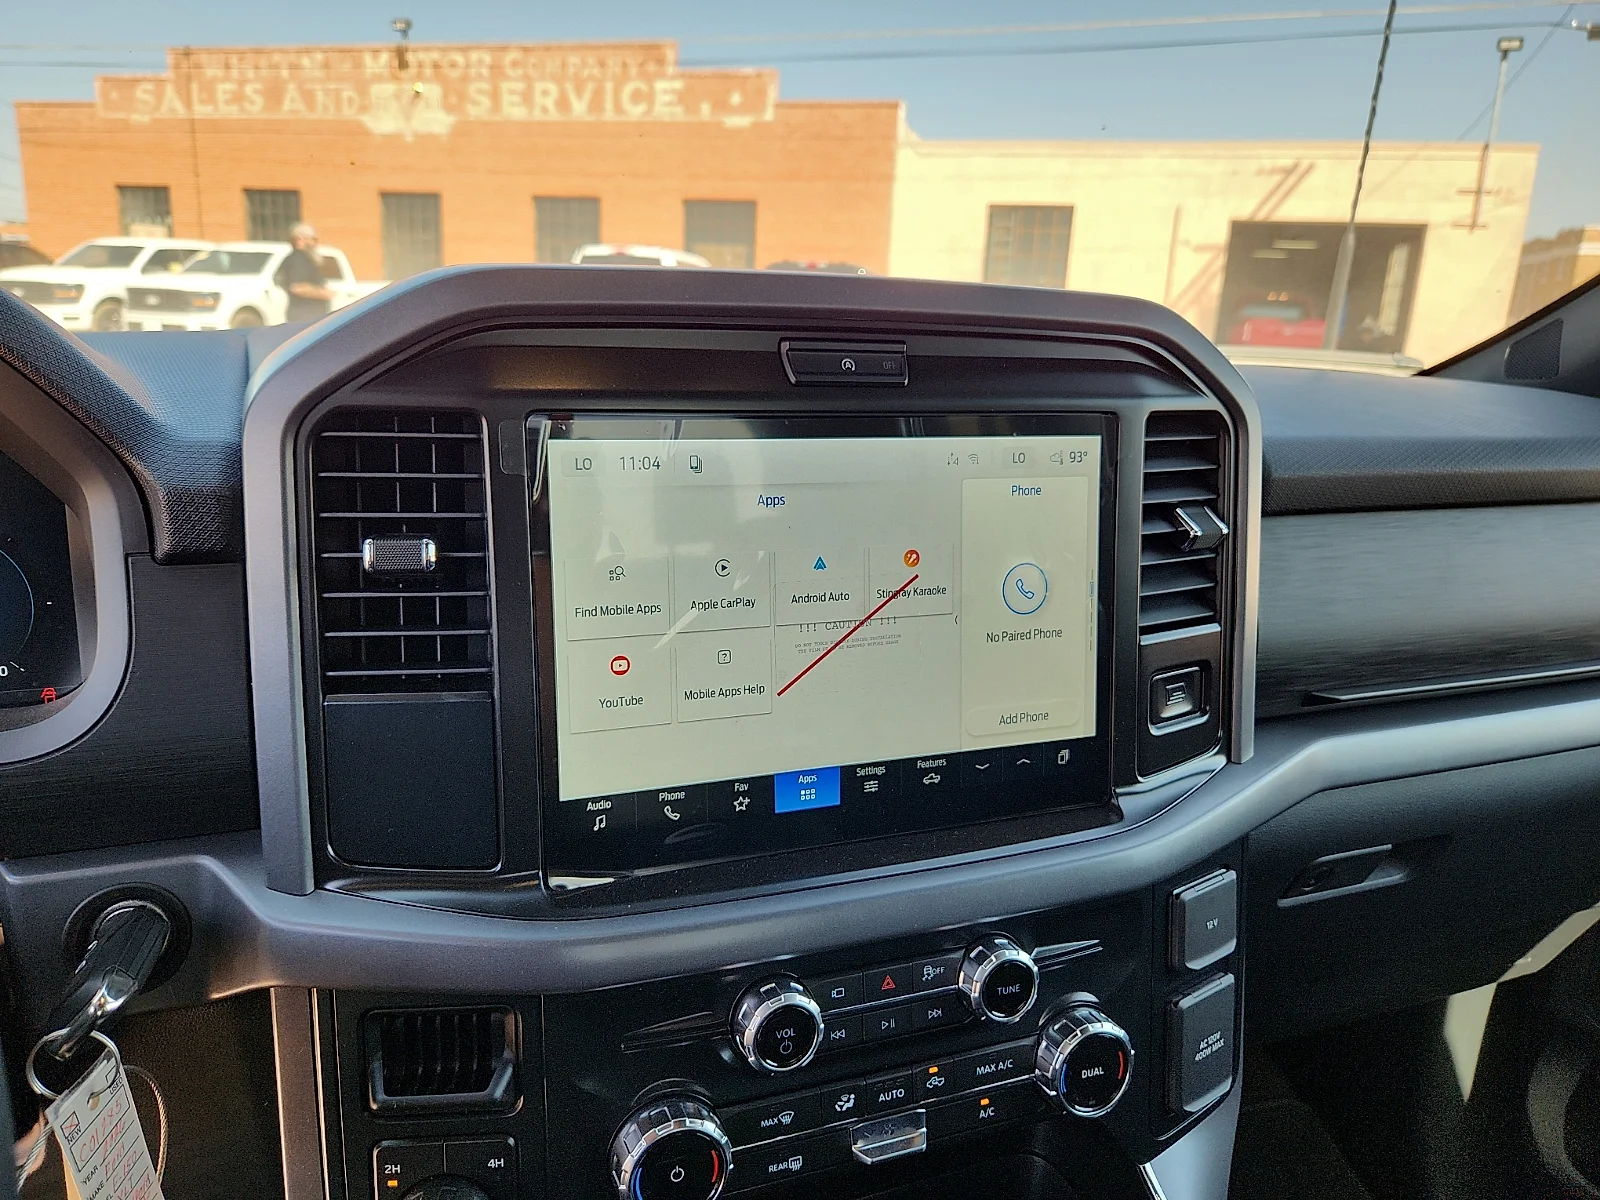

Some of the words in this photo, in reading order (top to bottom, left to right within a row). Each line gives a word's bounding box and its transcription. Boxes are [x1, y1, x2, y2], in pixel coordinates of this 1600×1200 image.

[135, 82, 264, 115] SALES
[282, 82, 360, 115] AND
[467, 79, 685, 118] SERVICE
[882, 361, 896, 370] OFF
[619, 456, 662, 471] 11:04
[1012, 452, 1026, 464] LO
[1069, 451, 1088, 463] 93°
[574, 457, 593, 471] LO
[1011, 485, 1042, 497] Phone
[757, 494, 787, 508] Apps
[913, 584, 947, 597] Karaoke
[791, 591, 827, 605] Android
[828, 590, 850, 602] Auto
[574, 607, 598, 618] Find
[600, 604, 634, 617] Mobile
[636, 602, 662, 616] Apps
[690, 599, 719, 613] Apple
[720, 597, 756, 610] CarPlay
[986, 632, 1000, 643] No
[1001, 629, 1032, 642] Paired
[1033, 628, 1063, 640] Phone
[684, 687, 716, 701] Mobile
[717, 686, 742, 700] Apps
[743, 684, 766, 697] Help
[598, 695, 644, 709] YouTube
[998, 713, 1018, 726] Add
[1019, 711, 1049, 723] Phone
[917, 758, 947, 769] Features
[856, 765, 886, 777] Settings
[798, 773, 818, 784] Apps
[734, 782, 749, 792] Fav
[658, 790, 686, 802] Phone
[586, 799, 612, 811] Audio
[1206, 917, 1218, 930] 12V
[931, 964, 946, 976] OFF
[997, 982, 1021, 996] TUNE
[775, 1027, 797, 1040] VOL
[976, 1062, 997, 1076] MAX
[997, 1059, 1014, 1072] A/C
[1081, 1066, 1105, 1079] DUAL
[109, 1077, 123, 1095] USED
[878, 1088, 905, 1103] AUTO
[979, 1106, 996, 1119] A/C
[760, 1115, 779, 1128] MAX
[67, 1126, 82, 1145] NEW
[384, 1163, 400, 1175] 2H
[487, 1156, 505, 1169] 4H
[768, 1159, 788, 1172] REAR
[82, 1164, 99, 1186] YEAR
